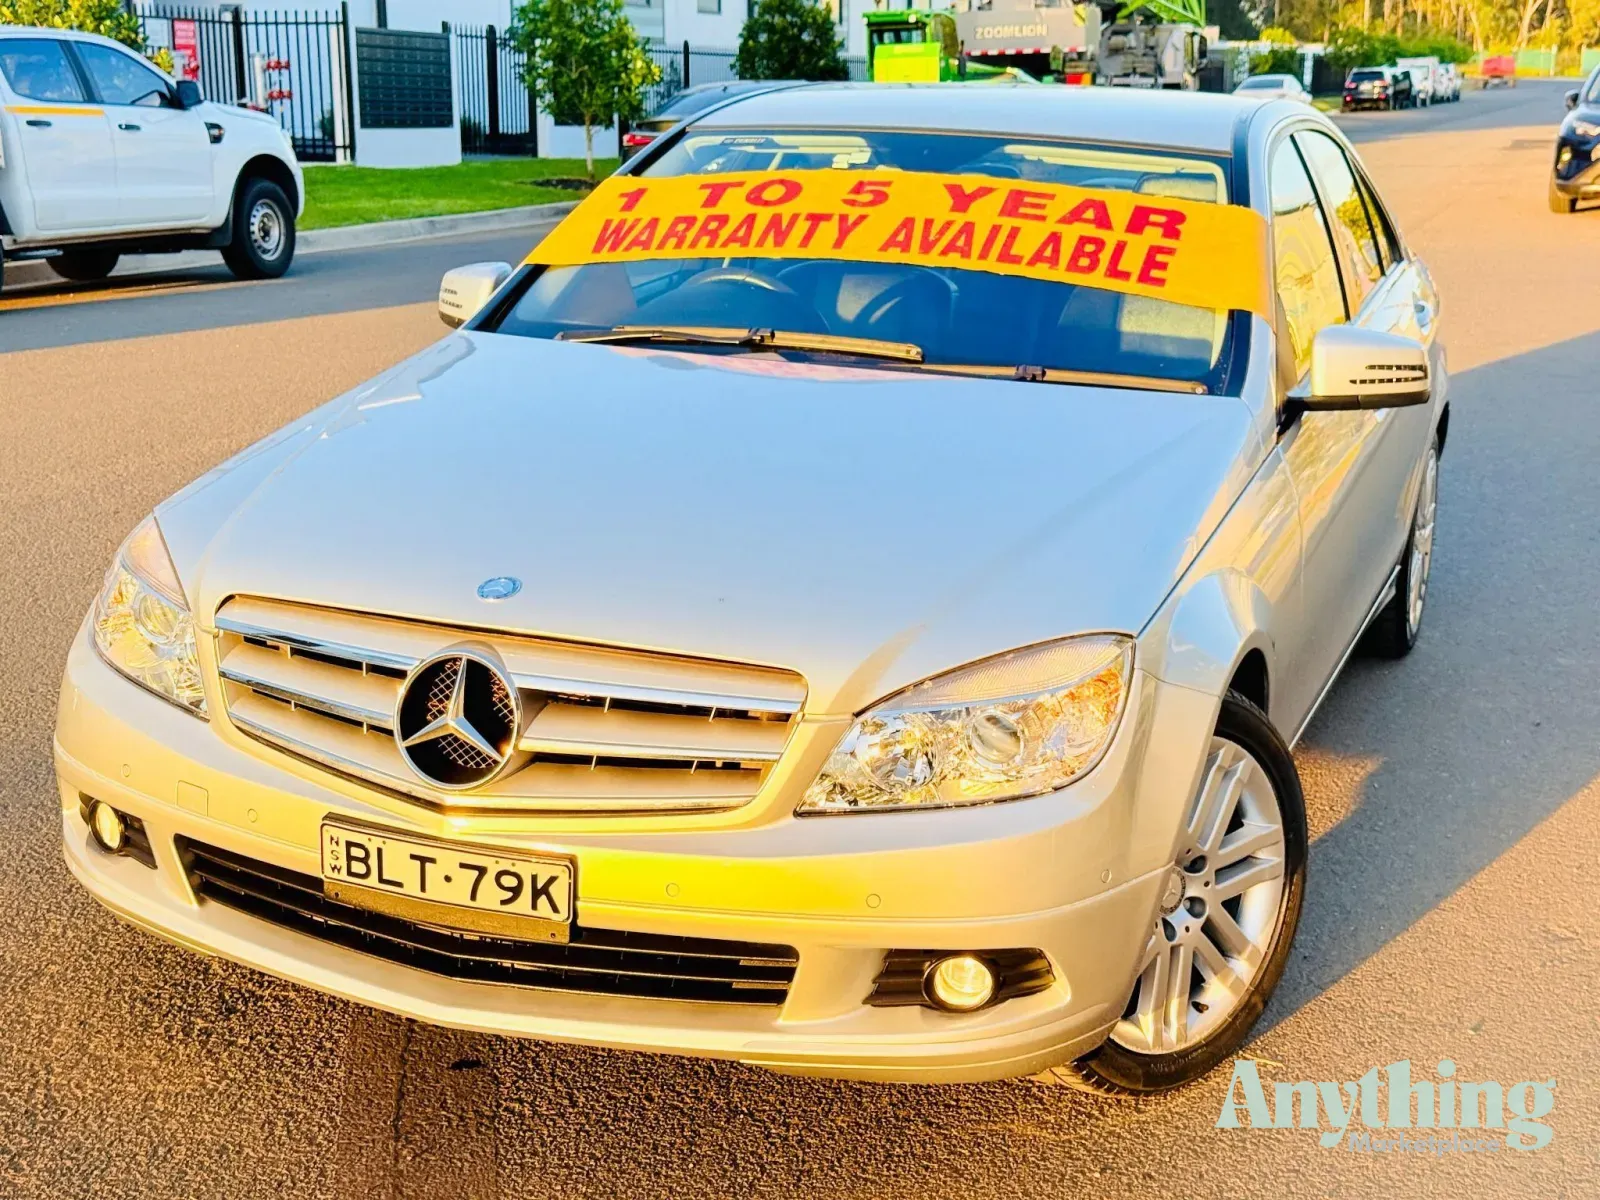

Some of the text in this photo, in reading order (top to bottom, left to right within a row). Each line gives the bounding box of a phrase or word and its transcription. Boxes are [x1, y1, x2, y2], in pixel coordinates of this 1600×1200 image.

[975, 24, 1048, 39] ZOOMLION
[619, 179, 1187, 241] 1 TO 5 YEAR
[592, 212, 1177, 288] WARRANTY AVAILABLE
